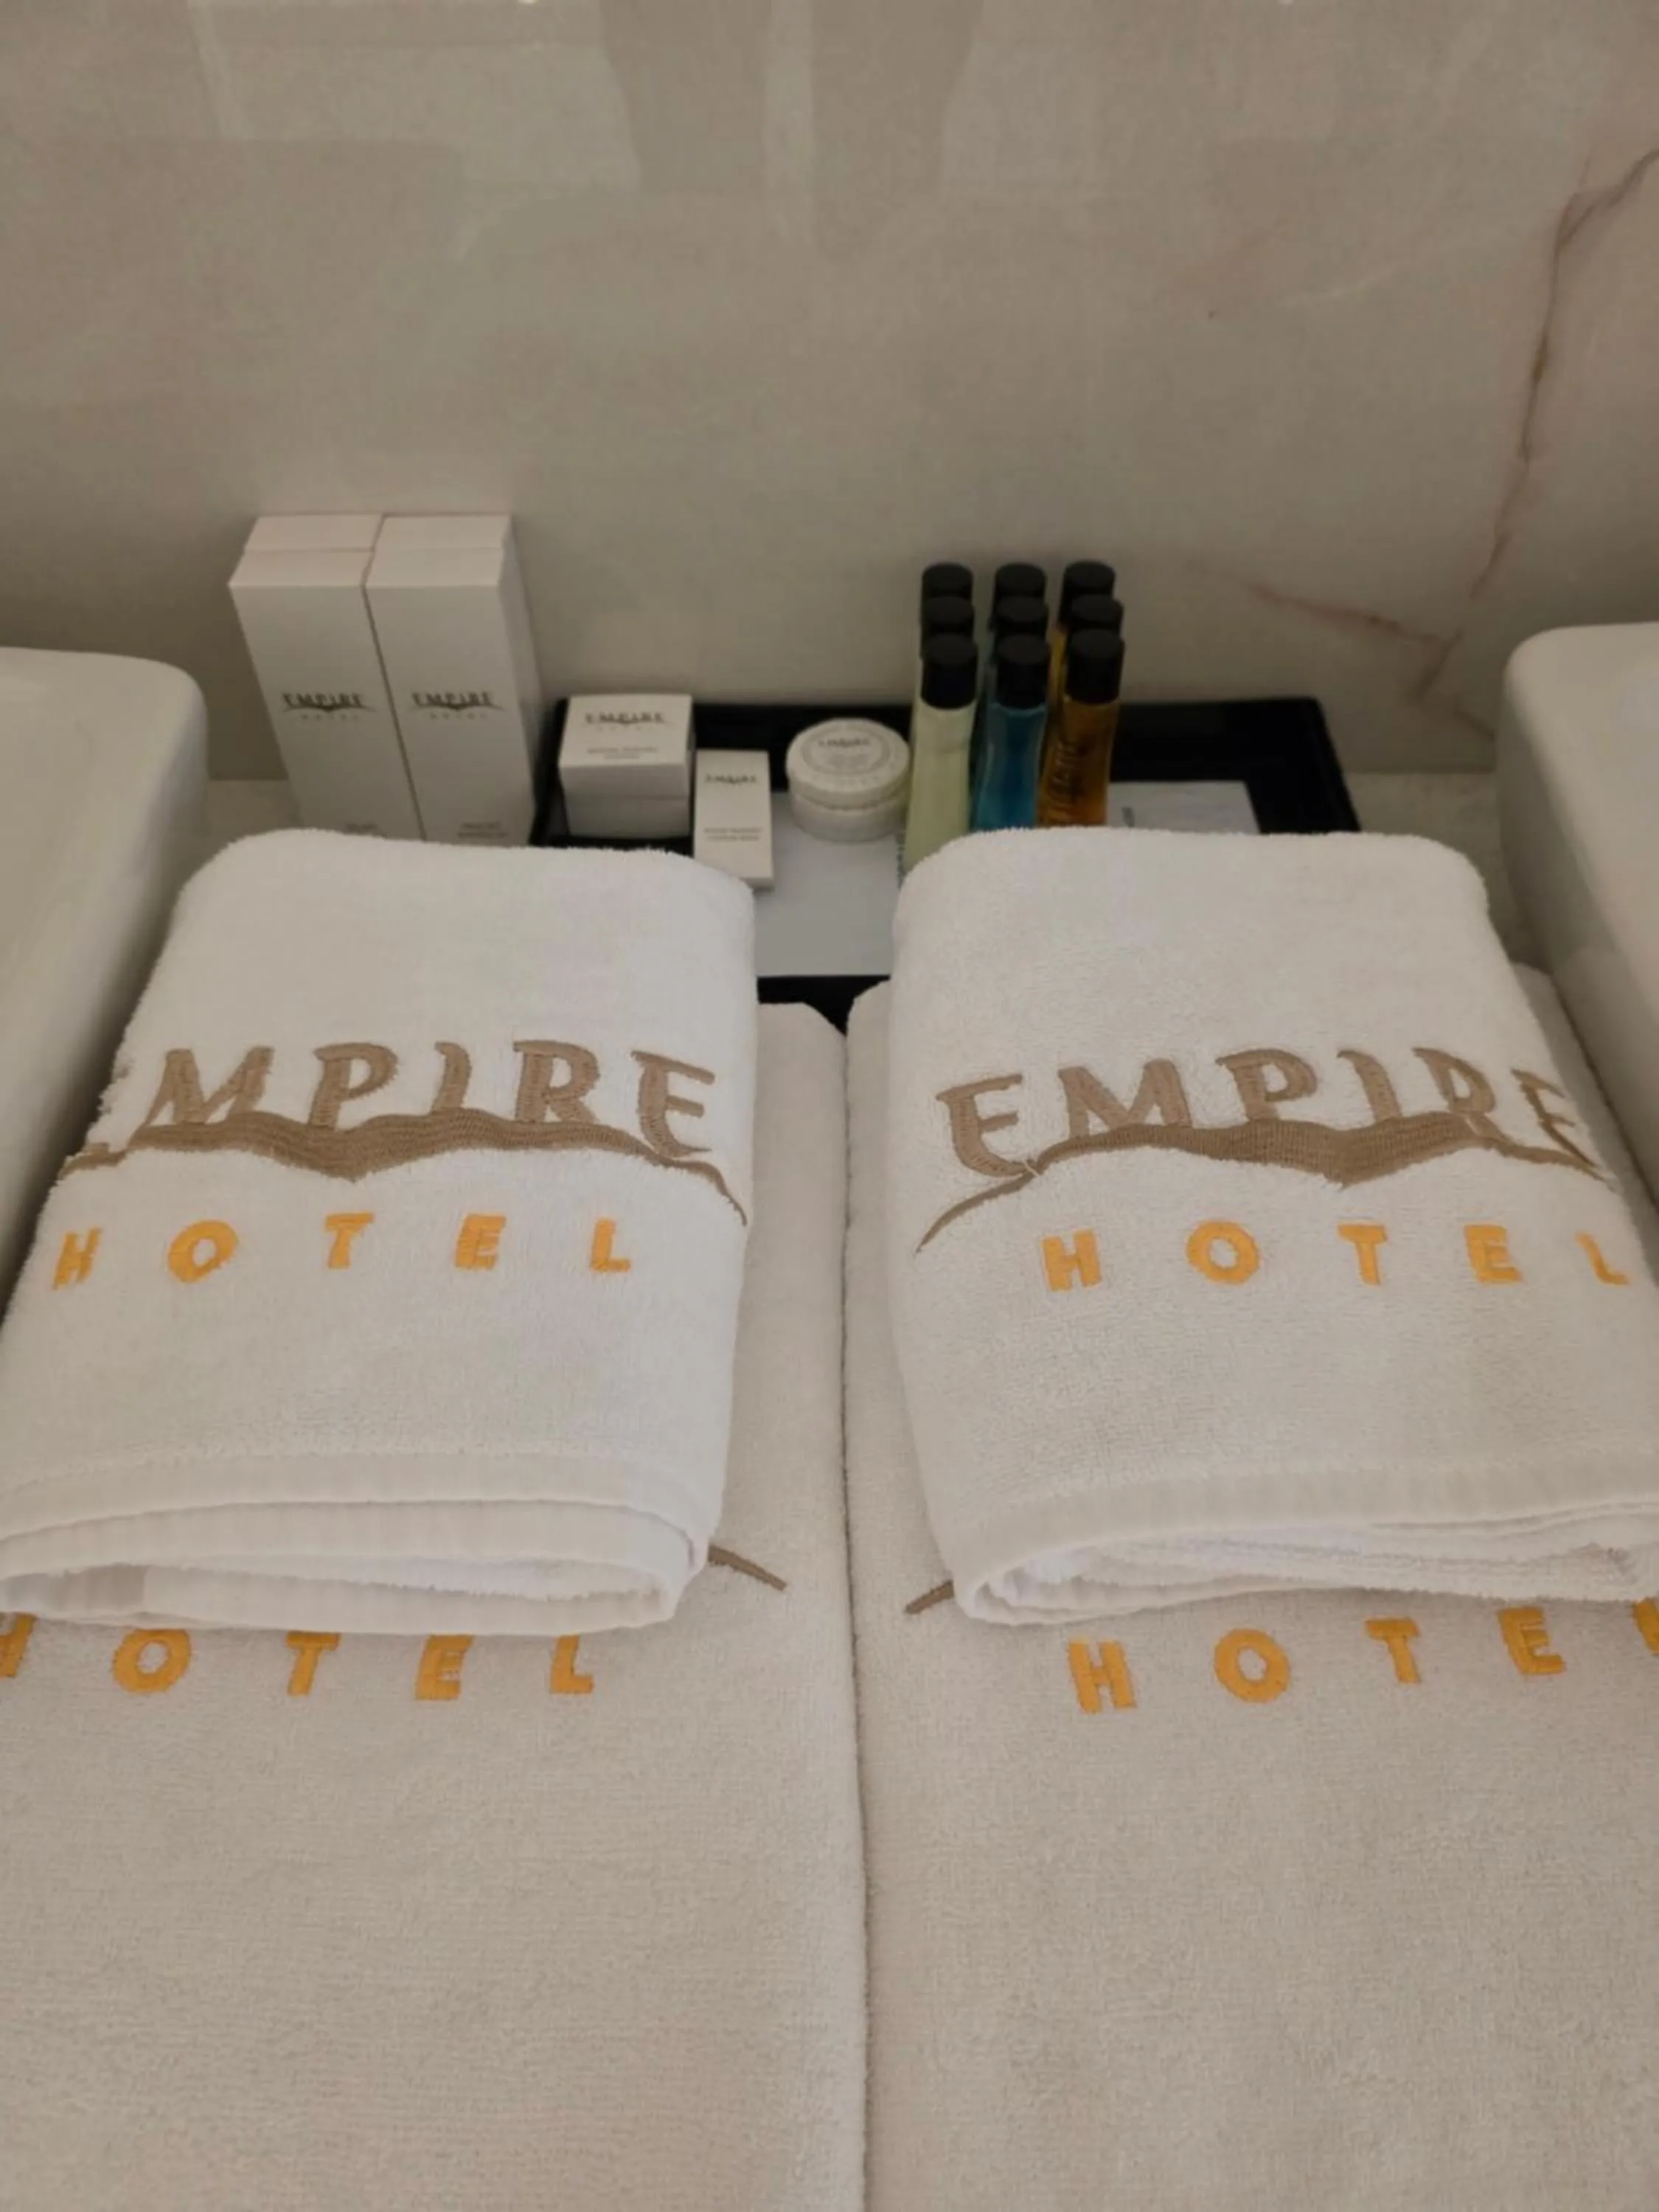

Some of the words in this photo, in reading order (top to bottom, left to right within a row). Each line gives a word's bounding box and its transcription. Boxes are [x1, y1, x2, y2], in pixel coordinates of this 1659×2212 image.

[83, 1041, 715, 1159] MPIRE
[936, 1048, 1599, 1178] EMPIRE
[52, 1211, 632, 1290] HOTEL
[1041, 1221, 1630, 1292] HOTEL
